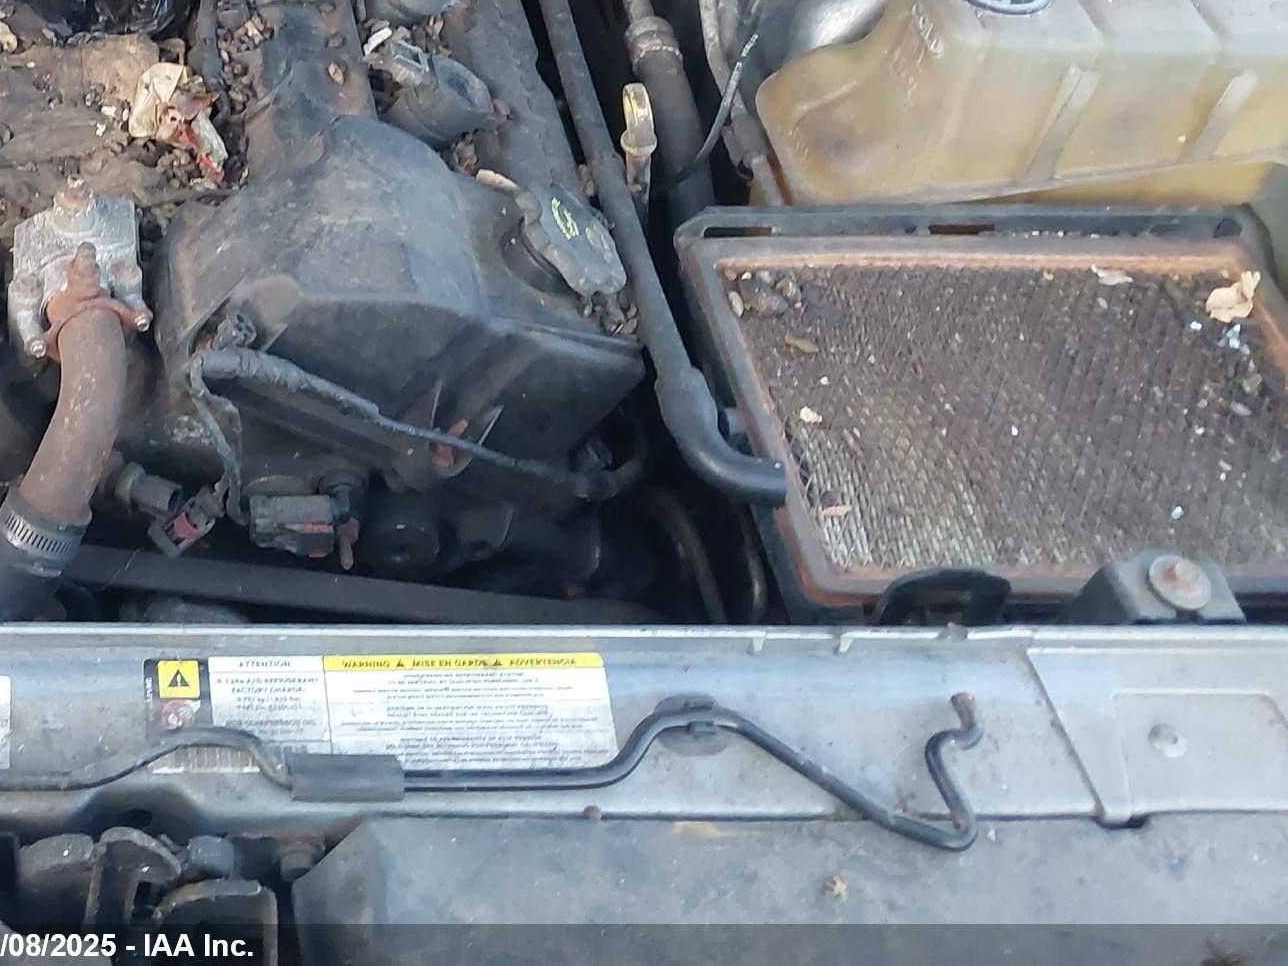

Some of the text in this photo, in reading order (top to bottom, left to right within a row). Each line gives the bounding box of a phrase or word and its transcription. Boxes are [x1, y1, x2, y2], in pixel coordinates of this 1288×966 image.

[342, 658, 577, 668] WARNING MISE EN GARDE ADVERTENCIA
